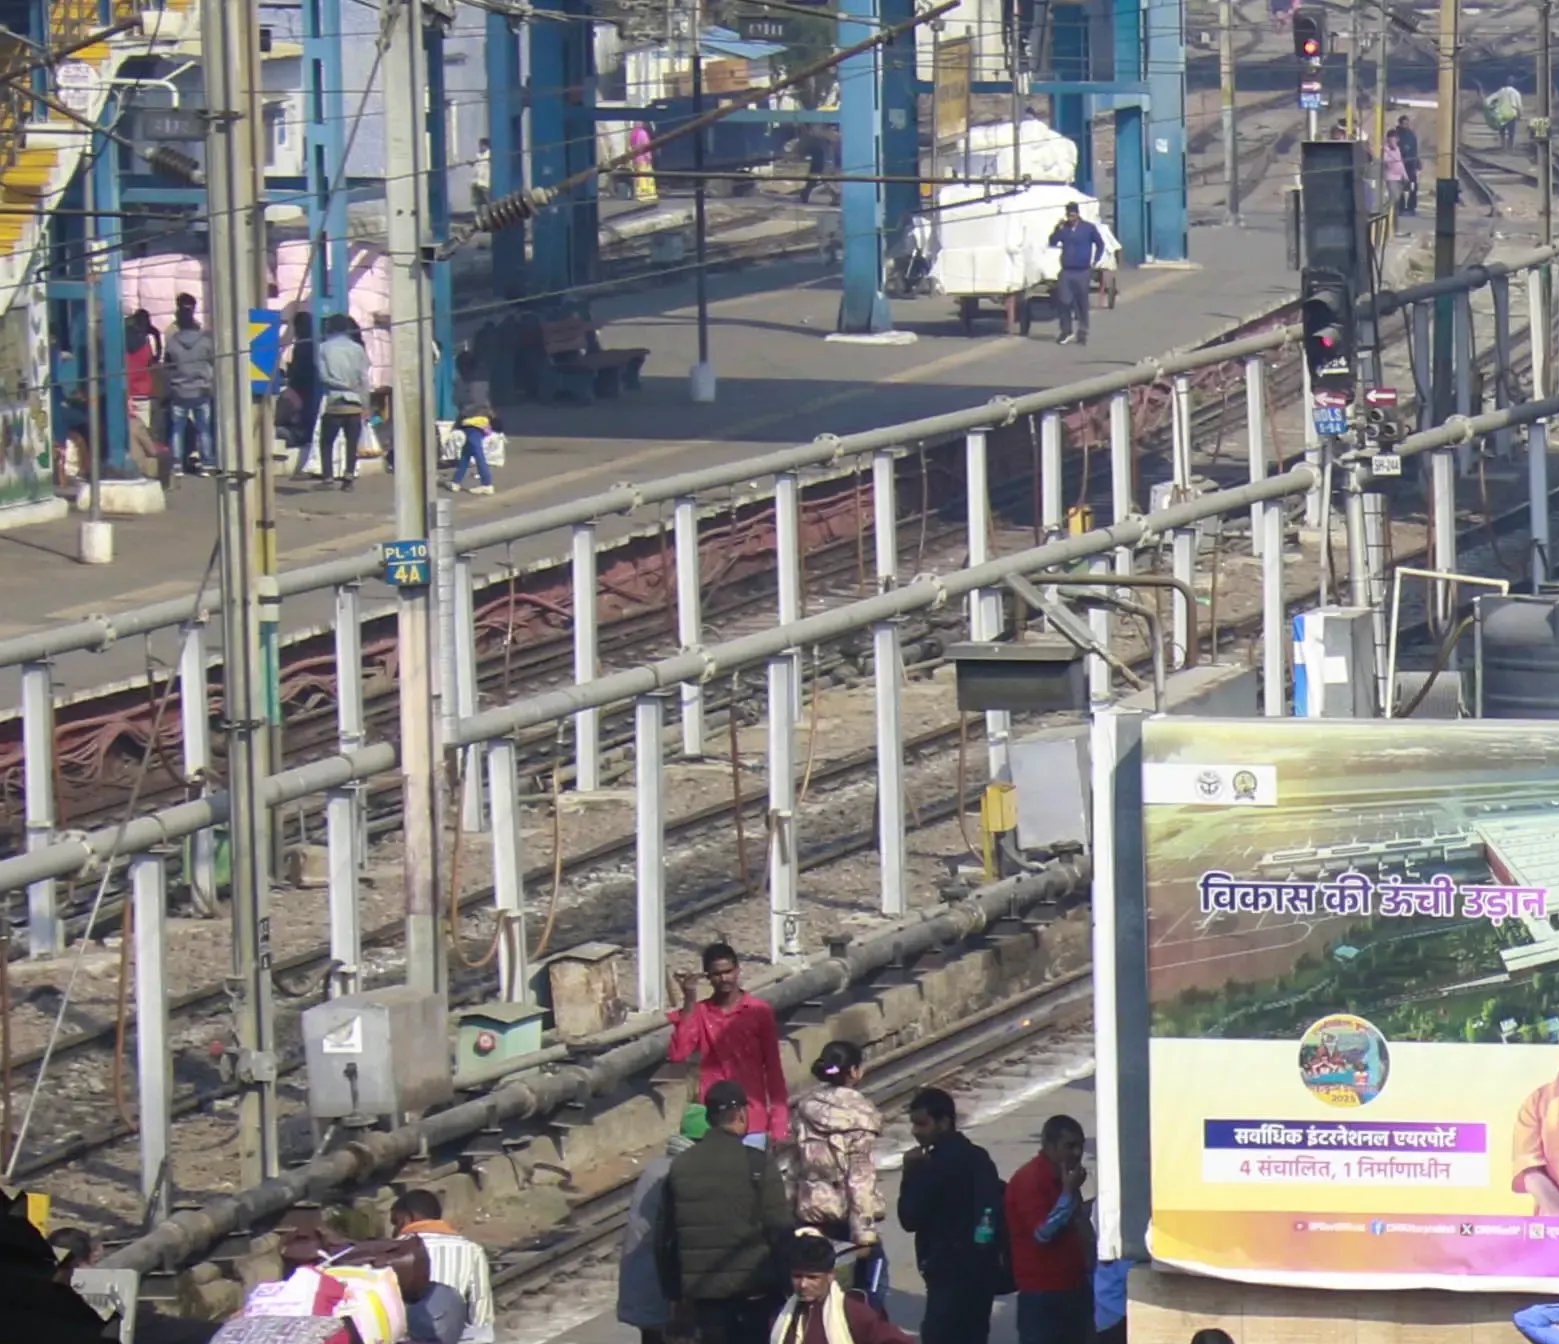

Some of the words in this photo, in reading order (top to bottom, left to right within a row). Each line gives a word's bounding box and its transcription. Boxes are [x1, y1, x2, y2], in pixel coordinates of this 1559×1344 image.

[384, 544, 427, 559] PL-10
[394, 565, 421, 583] 4A
[1199, 871, 1316, 914] विकास
[1321, 873, 1372, 915] की
[1377, 874, 1454, 917] ऊंची
[1461, 885, 1548, 926] उड़ान
[1233, 1124, 1303, 1146] सर्वाधिक
[1307, 1125, 1389, 1147] इंटरनेशनल
[1392, 1126, 1456, 1148] एयरपोर्ट
[1239, 1160, 1251, 1176] 4
[1257, 1155, 1336, 1181] संचालित,
[1343, 1162, 1351, 1177] 1
[1357, 1155, 1451, 1180] निर्माणाधीन
